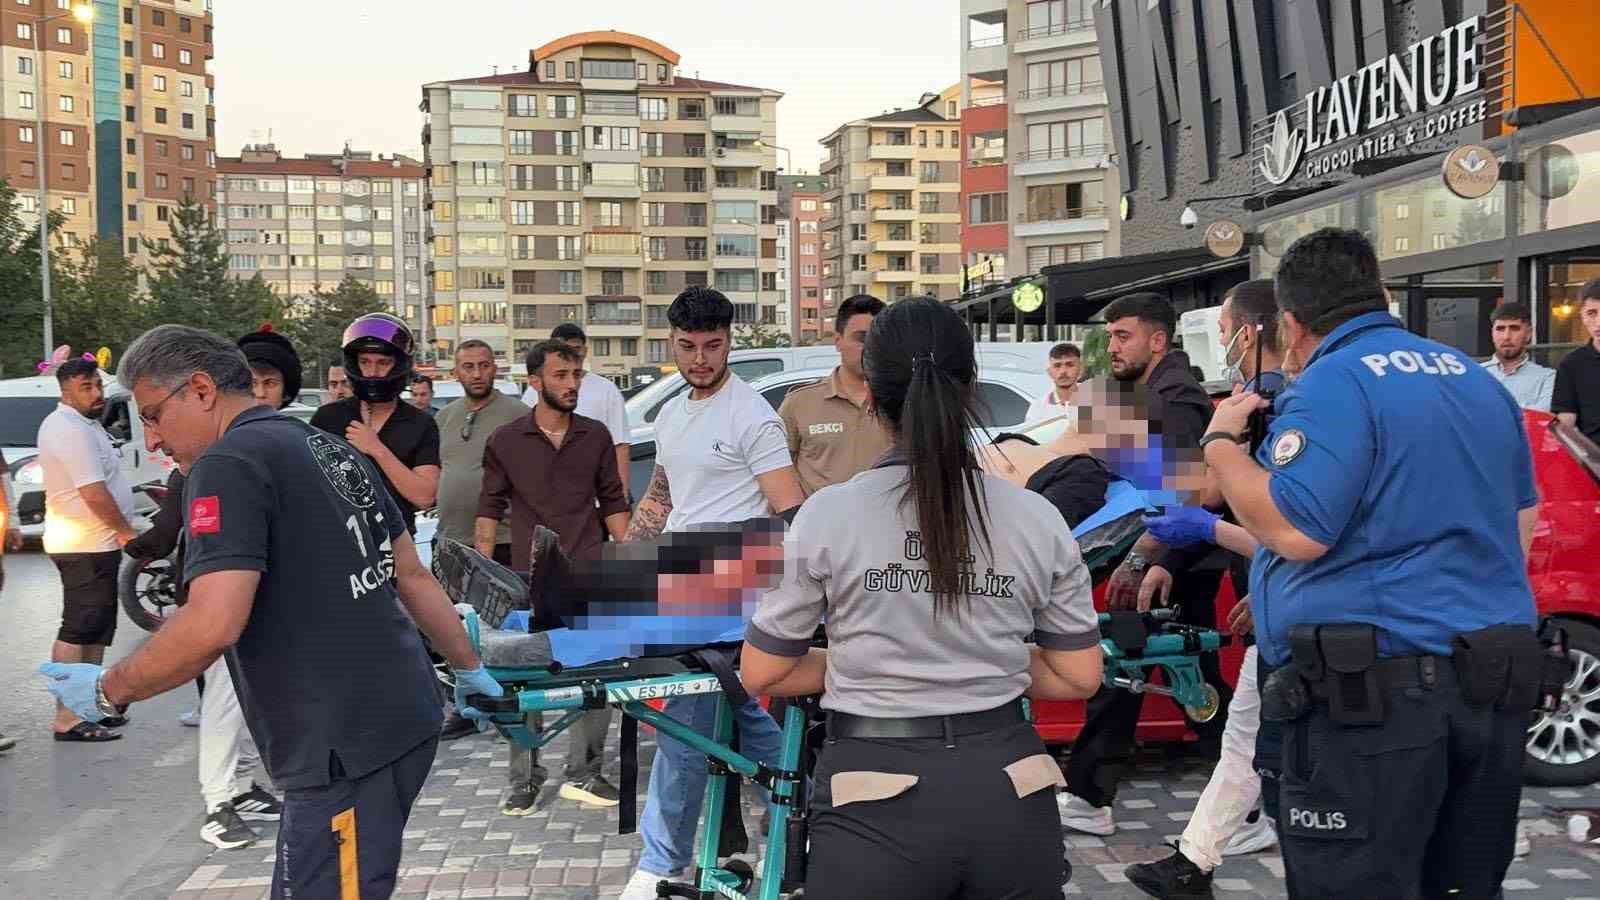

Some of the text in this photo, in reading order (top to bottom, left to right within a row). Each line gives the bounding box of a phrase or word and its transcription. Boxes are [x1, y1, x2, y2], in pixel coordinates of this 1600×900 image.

[1304, 16, 1481, 152] L'AVENUE
[1306, 99, 1488, 179] CHOCOLATIER & COFFEE
[639, 686, 657, 698] ES
[663, 683, 685, 696] 125
